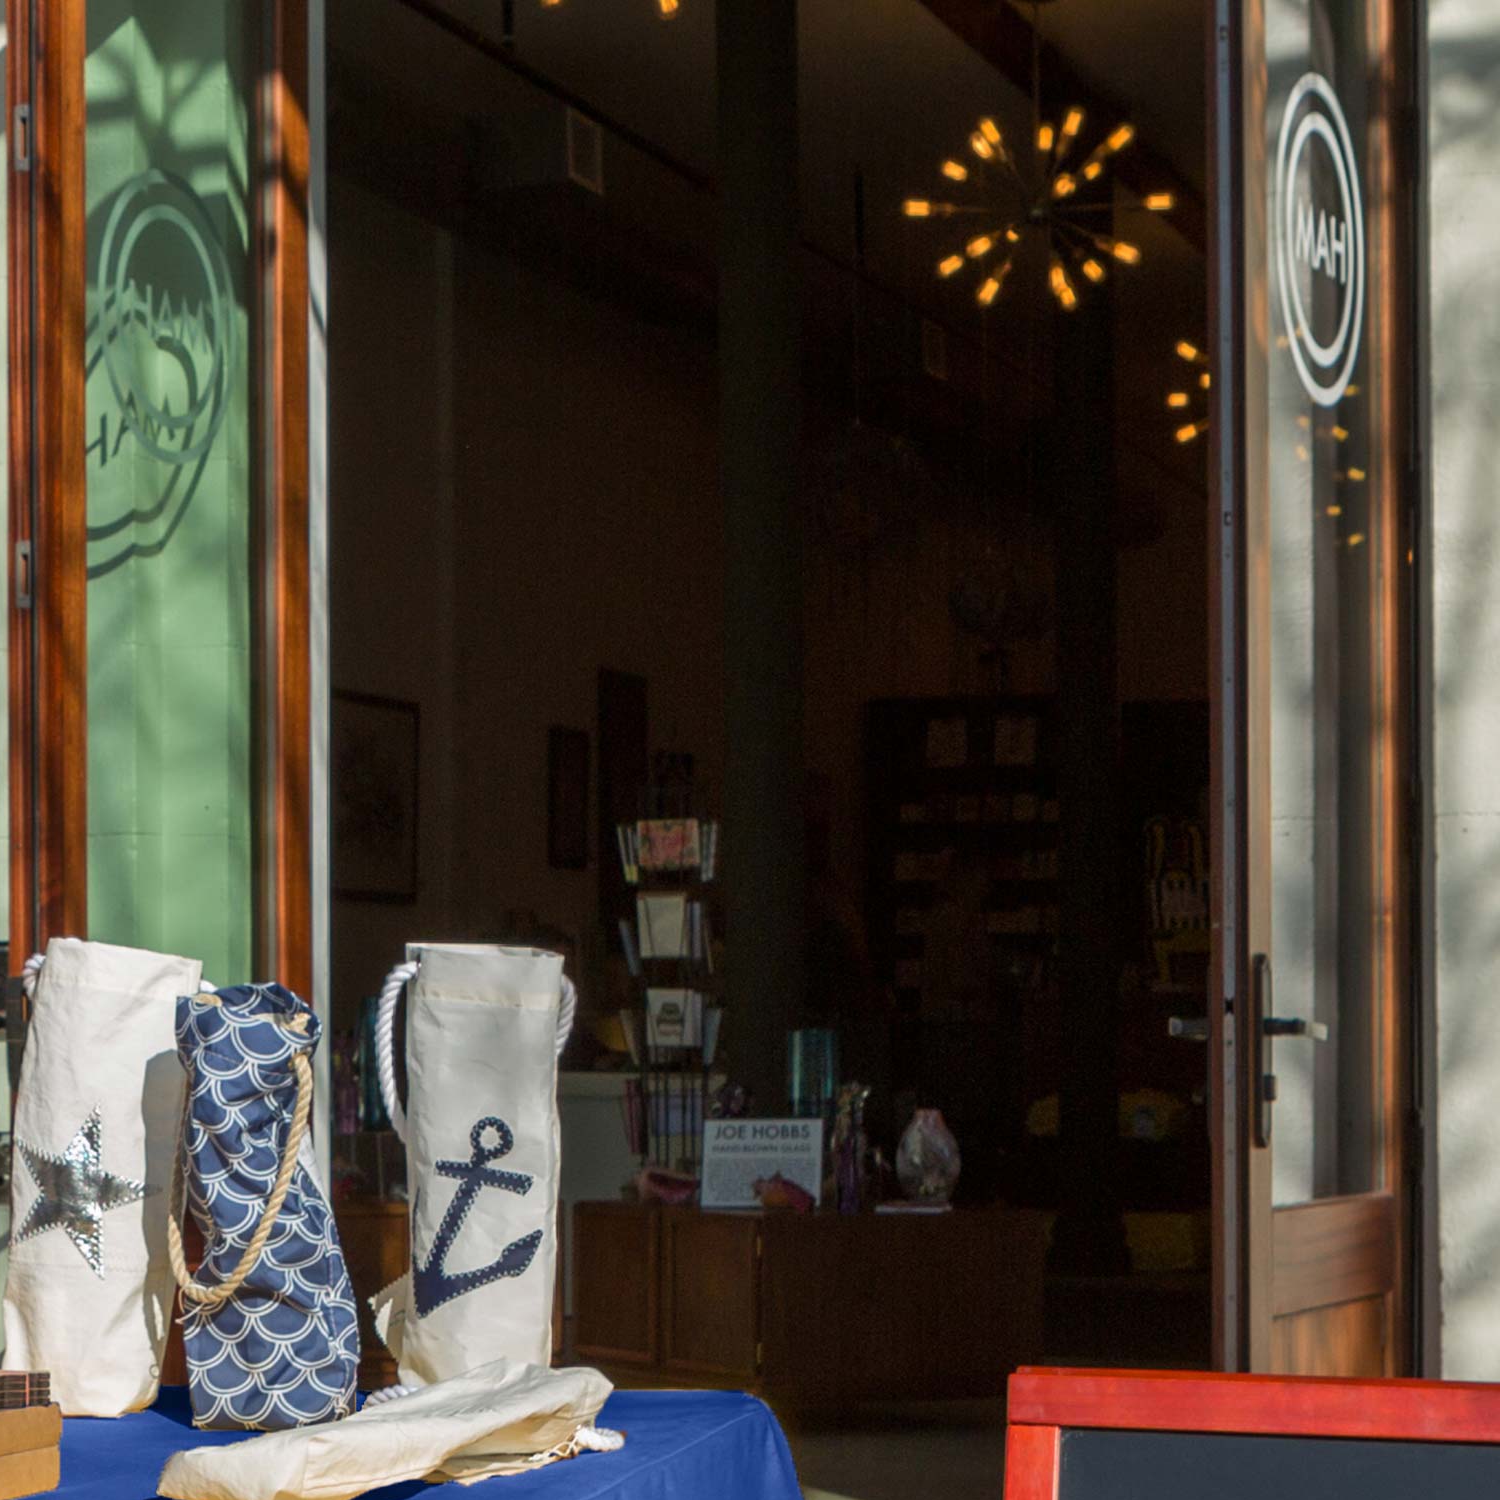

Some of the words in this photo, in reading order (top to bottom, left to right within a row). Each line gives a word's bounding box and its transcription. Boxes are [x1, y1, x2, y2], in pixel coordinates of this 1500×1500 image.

[1295, 197, 1346, 284] MAH
[715, 1123, 747, 1140] JOE
[752, 1123, 811, 1140] HOBBS
